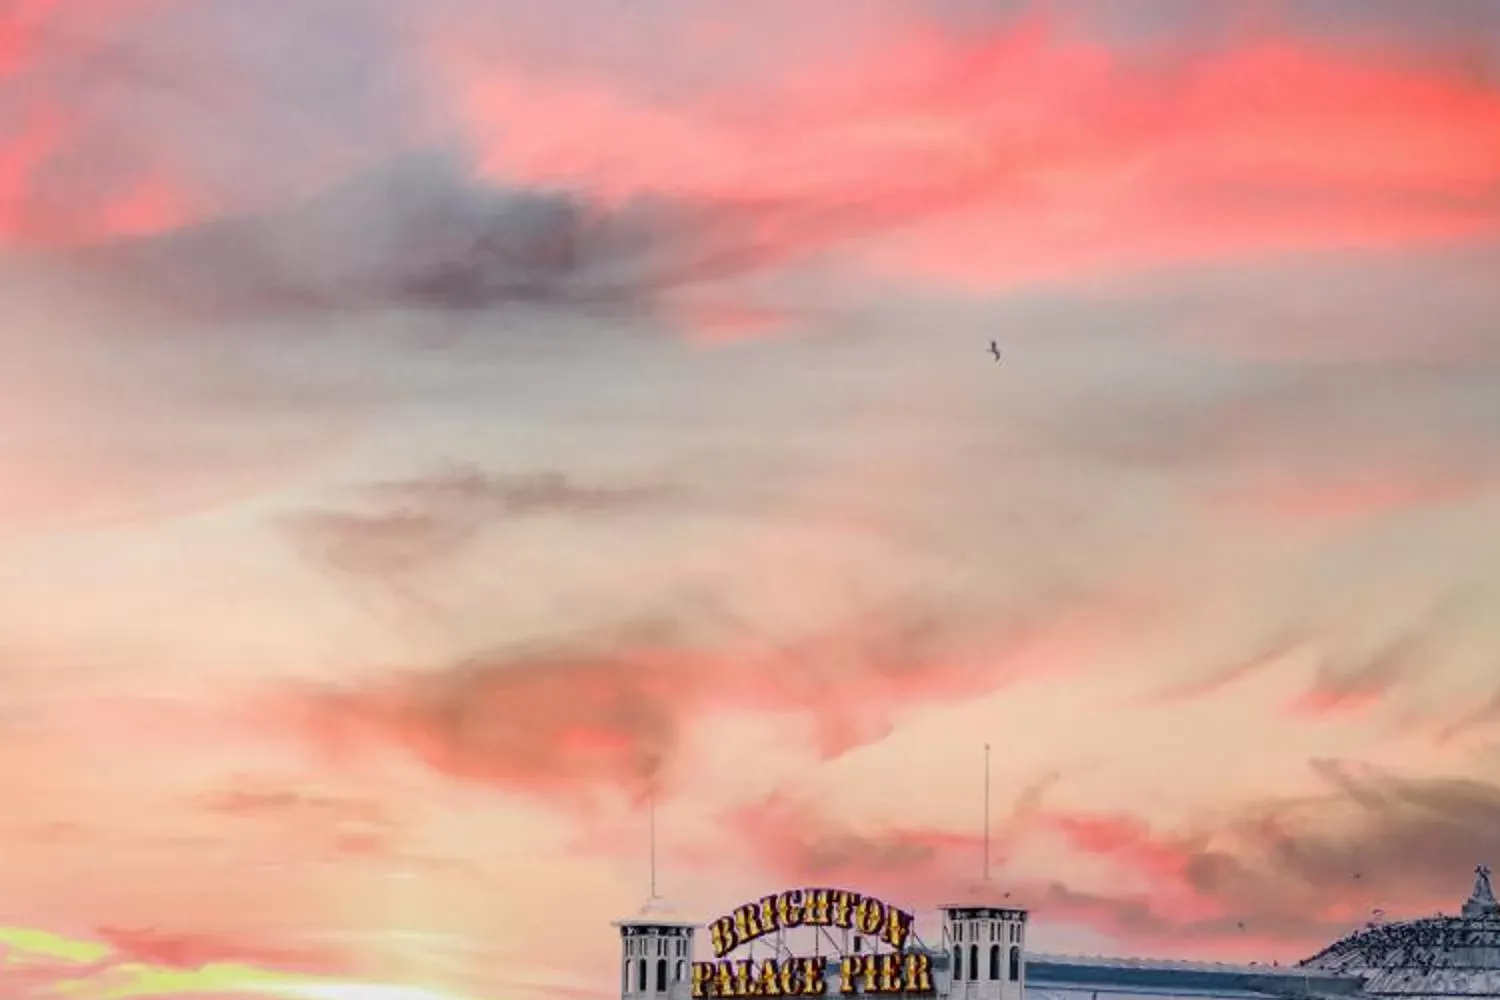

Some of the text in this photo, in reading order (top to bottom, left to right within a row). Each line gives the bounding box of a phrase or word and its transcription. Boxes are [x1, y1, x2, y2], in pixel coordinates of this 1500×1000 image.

[708, 887, 914, 957] BRIGHTON
[692, 951, 934, 998] PALACE PIER
